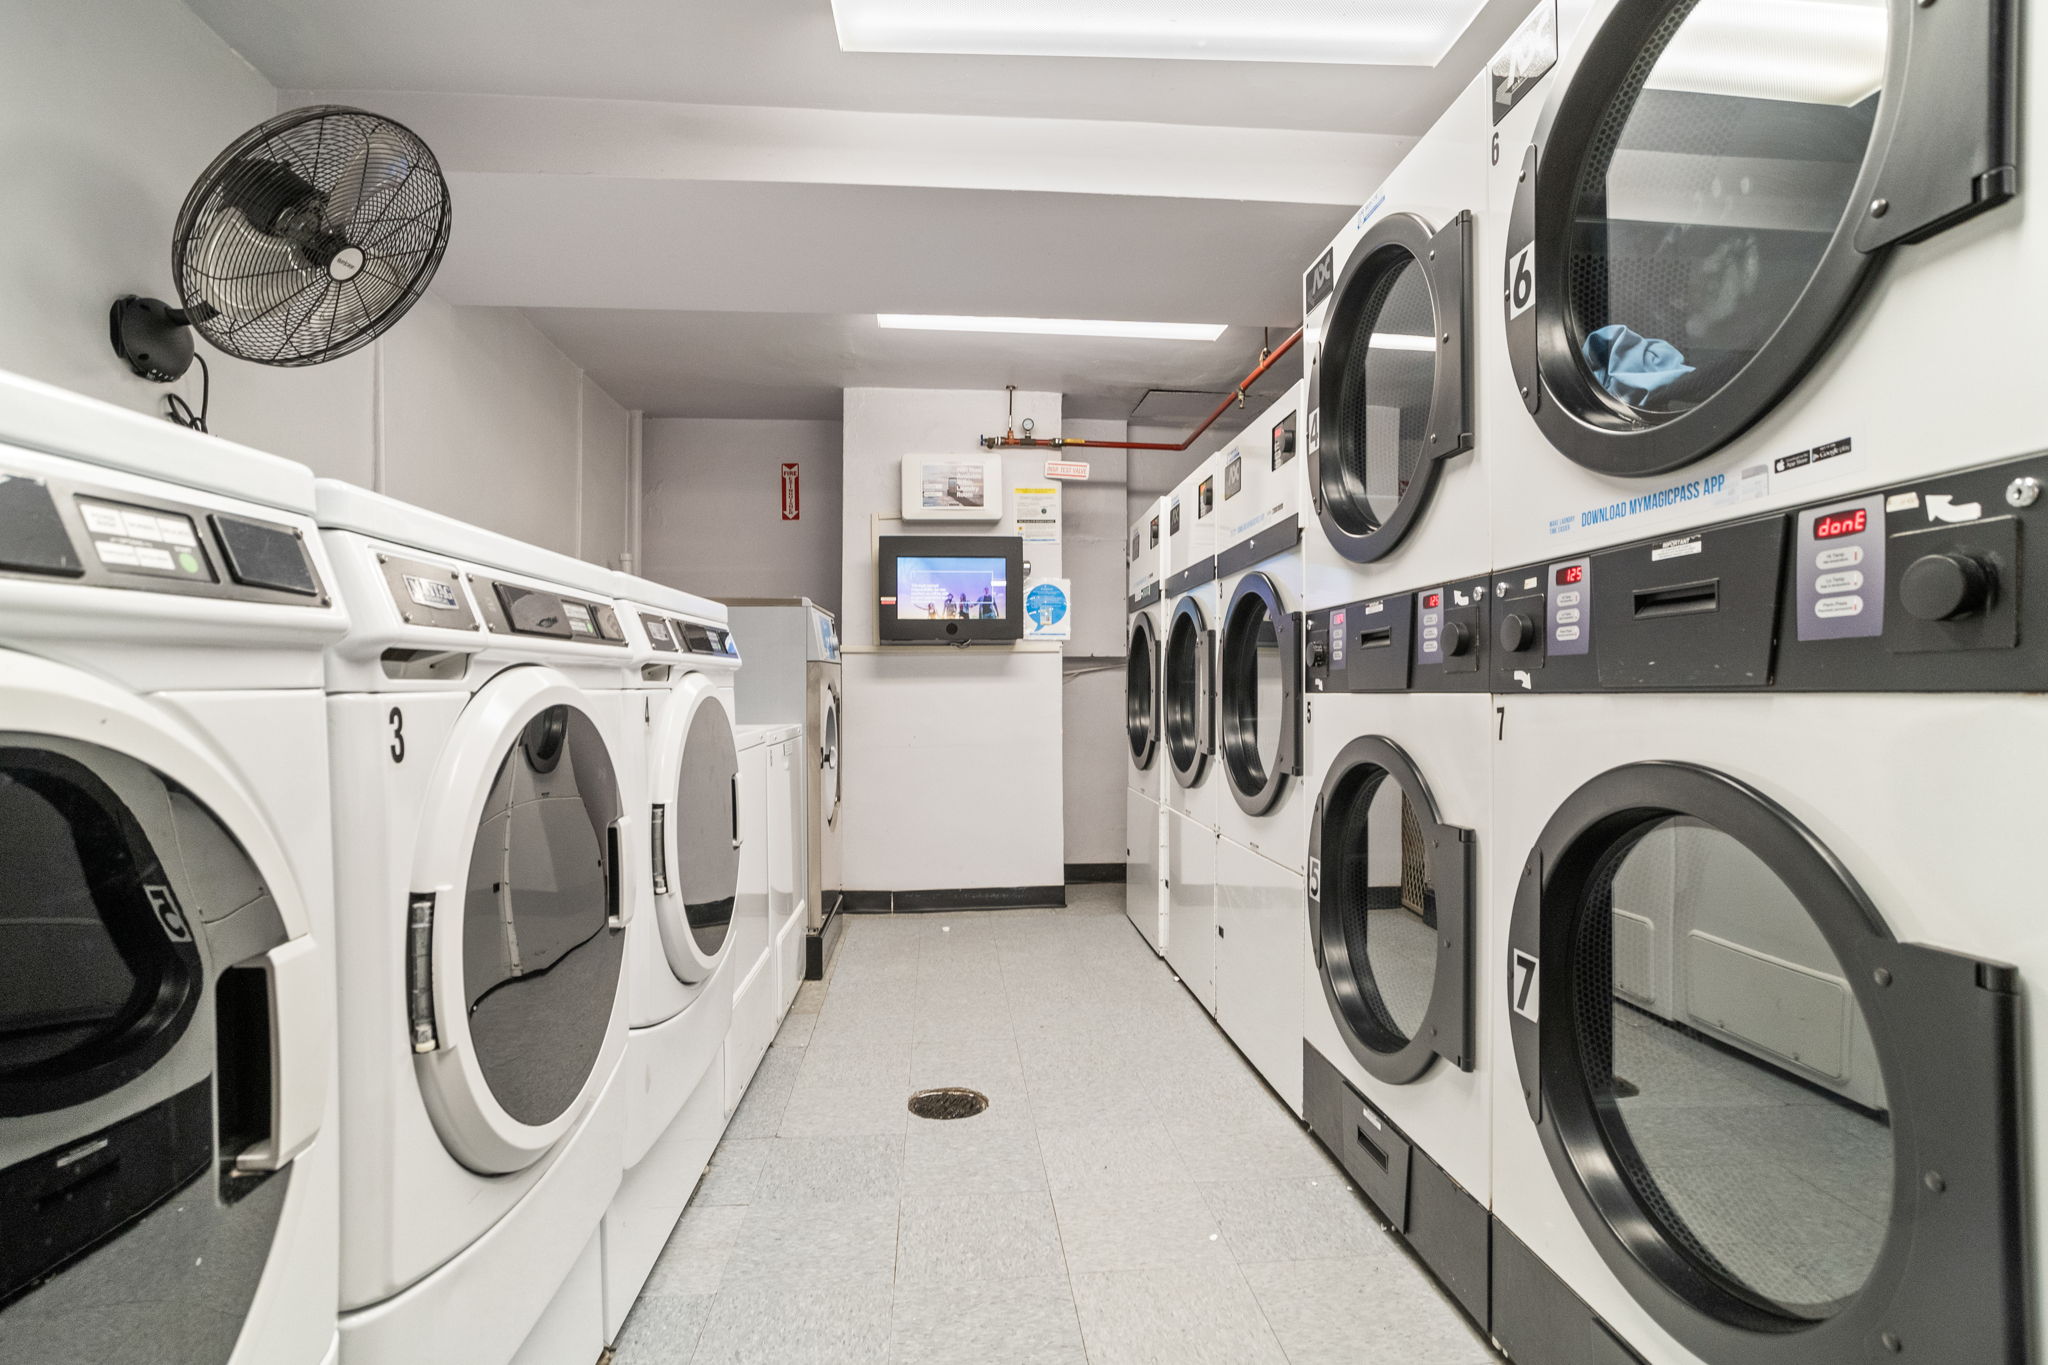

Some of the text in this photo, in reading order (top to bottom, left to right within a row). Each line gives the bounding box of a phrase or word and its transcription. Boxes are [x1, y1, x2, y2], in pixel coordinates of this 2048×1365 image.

[1492, 131, 1500, 166] 6
[1513, 249, 1532, 310] 6
[1310, 410, 1319, 448] 4
[1580, 473, 1726, 528] DOWNLOAD MYMAGICPASS APP
[1817, 509, 1866, 538] donE
[1567, 567, 1582, 583] 125
[1306, 701, 1312, 724] 5
[1497, 706, 1505, 741] 7
[389, 706, 405, 764] 3
[1310, 862, 1320, 898] 5
[1516, 953, 1537, 1012] 7
